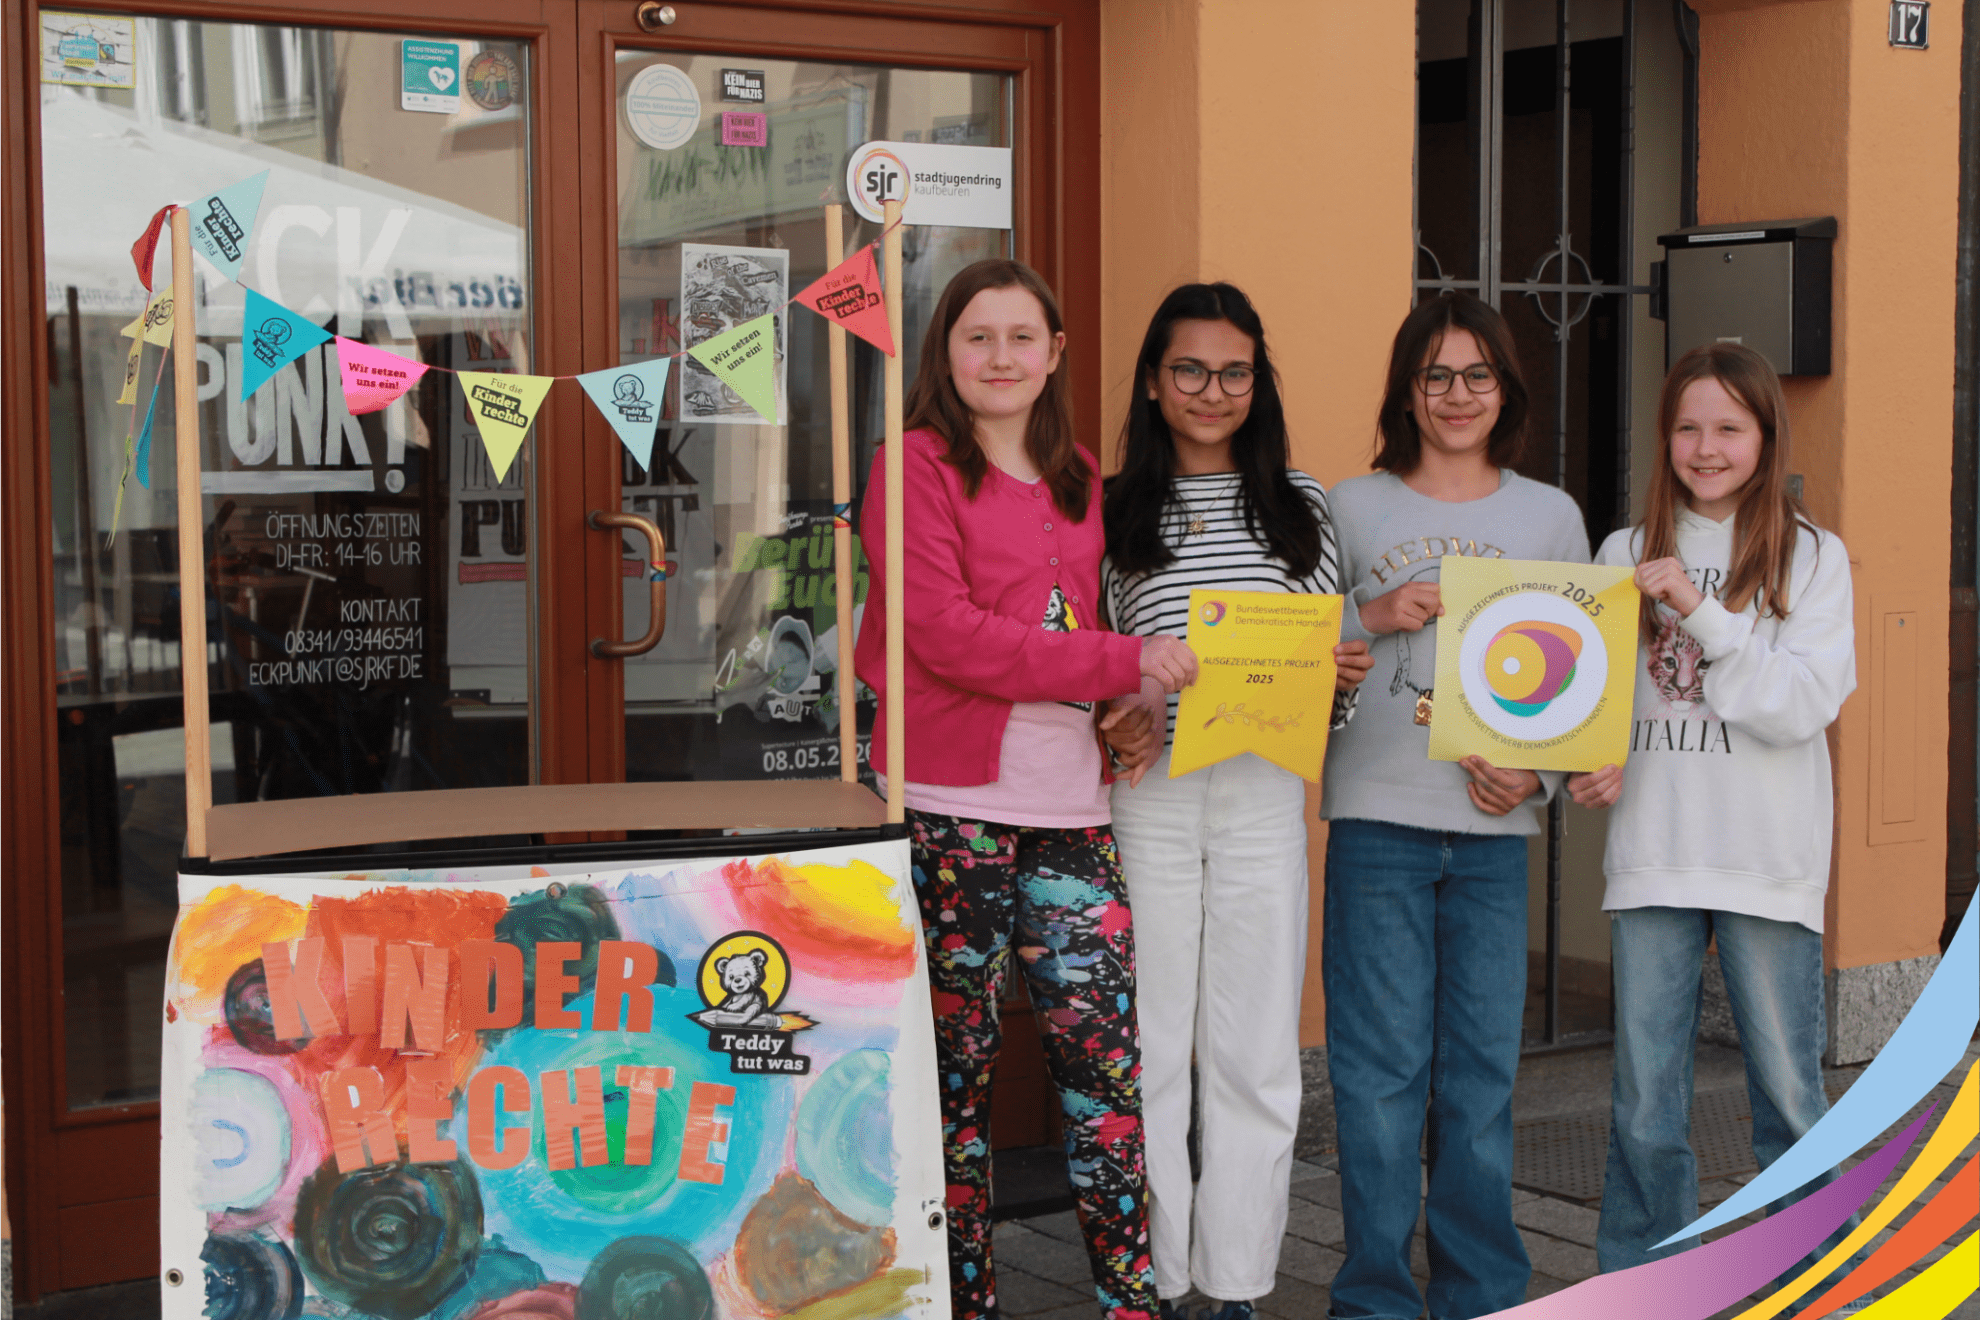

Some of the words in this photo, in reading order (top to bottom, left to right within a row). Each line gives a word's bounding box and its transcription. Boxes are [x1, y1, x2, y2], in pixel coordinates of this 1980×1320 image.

[1897, 4, 1922, 43] 17
[407, 53, 447, 62] WILLKOMMEN
[724, 73, 745, 87] KEIN
[745, 79, 760, 89] BIER
[727, 86, 739, 96] FÜR
[739, 88, 763, 99] NAZIS
[633, 101, 651, 109] 100%
[866, 164, 898, 202] sjr
[914, 172, 1002, 190] stadtjugendring
[914, 184, 971, 197] kaufbeuren
[210, 199, 243, 239] rechte
[207, 217, 240, 260] Kinder
[819, 287, 862, 309] Kinder
[710, 350, 731, 366] Wir
[731, 328, 761, 350] setzen
[727, 356, 746, 371] uns
[745, 342, 764, 358] ein!
[348, 362, 369, 374] Wir
[371, 367, 407, 379] setzen
[356, 378, 377, 388] uns
[379, 379, 400, 390] ein!
[491, 377, 507, 390] Für
[509, 383, 524, 395] die
[473, 387, 518, 411] Kinder
[483, 404, 525, 427] rechte
[266, 511, 420, 539] ÖFFNUNGSZEITEN
[276, 543, 329, 568] DI-FR:
[335, 542, 383, 566] 14-16
[390, 541, 422, 566] UHR
[341, 598, 422, 623] KONTAKT
[1236, 604, 1319, 616] Bundeswettbewerb
[1457, 583, 1520, 635] AUSGEZEICHNETES
[1521, 582, 1559, 593] PROJEKT
[1562, 582, 1605, 617] 2025
[1235, 616, 1294, 627] Demokratisch
[1296, 617, 1332, 628] Handeln
[285, 627, 423, 654] 08341/93446541
[1202, 656, 1282, 667] AUSGEZEICHNETES
[1284, 659, 1321, 668] PROJEKT
[1246, 673, 1274, 684] 2025
[1457, 692, 1523, 749] BUNDESWETTBEWERB
[1523, 727, 1582, 750] DEMOKRATISCH
[1578, 696, 1608, 732] HANDELN
[1632, 719, 1732, 754] ITALIA
[261, 935, 659, 1051] KINDER
[721, 1034, 786, 1055] Teddy
[737, 1056, 763, 1069] tut
[767, 1058, 804, 1071] was
[317, 1060, 737, 1185] RECHTE
